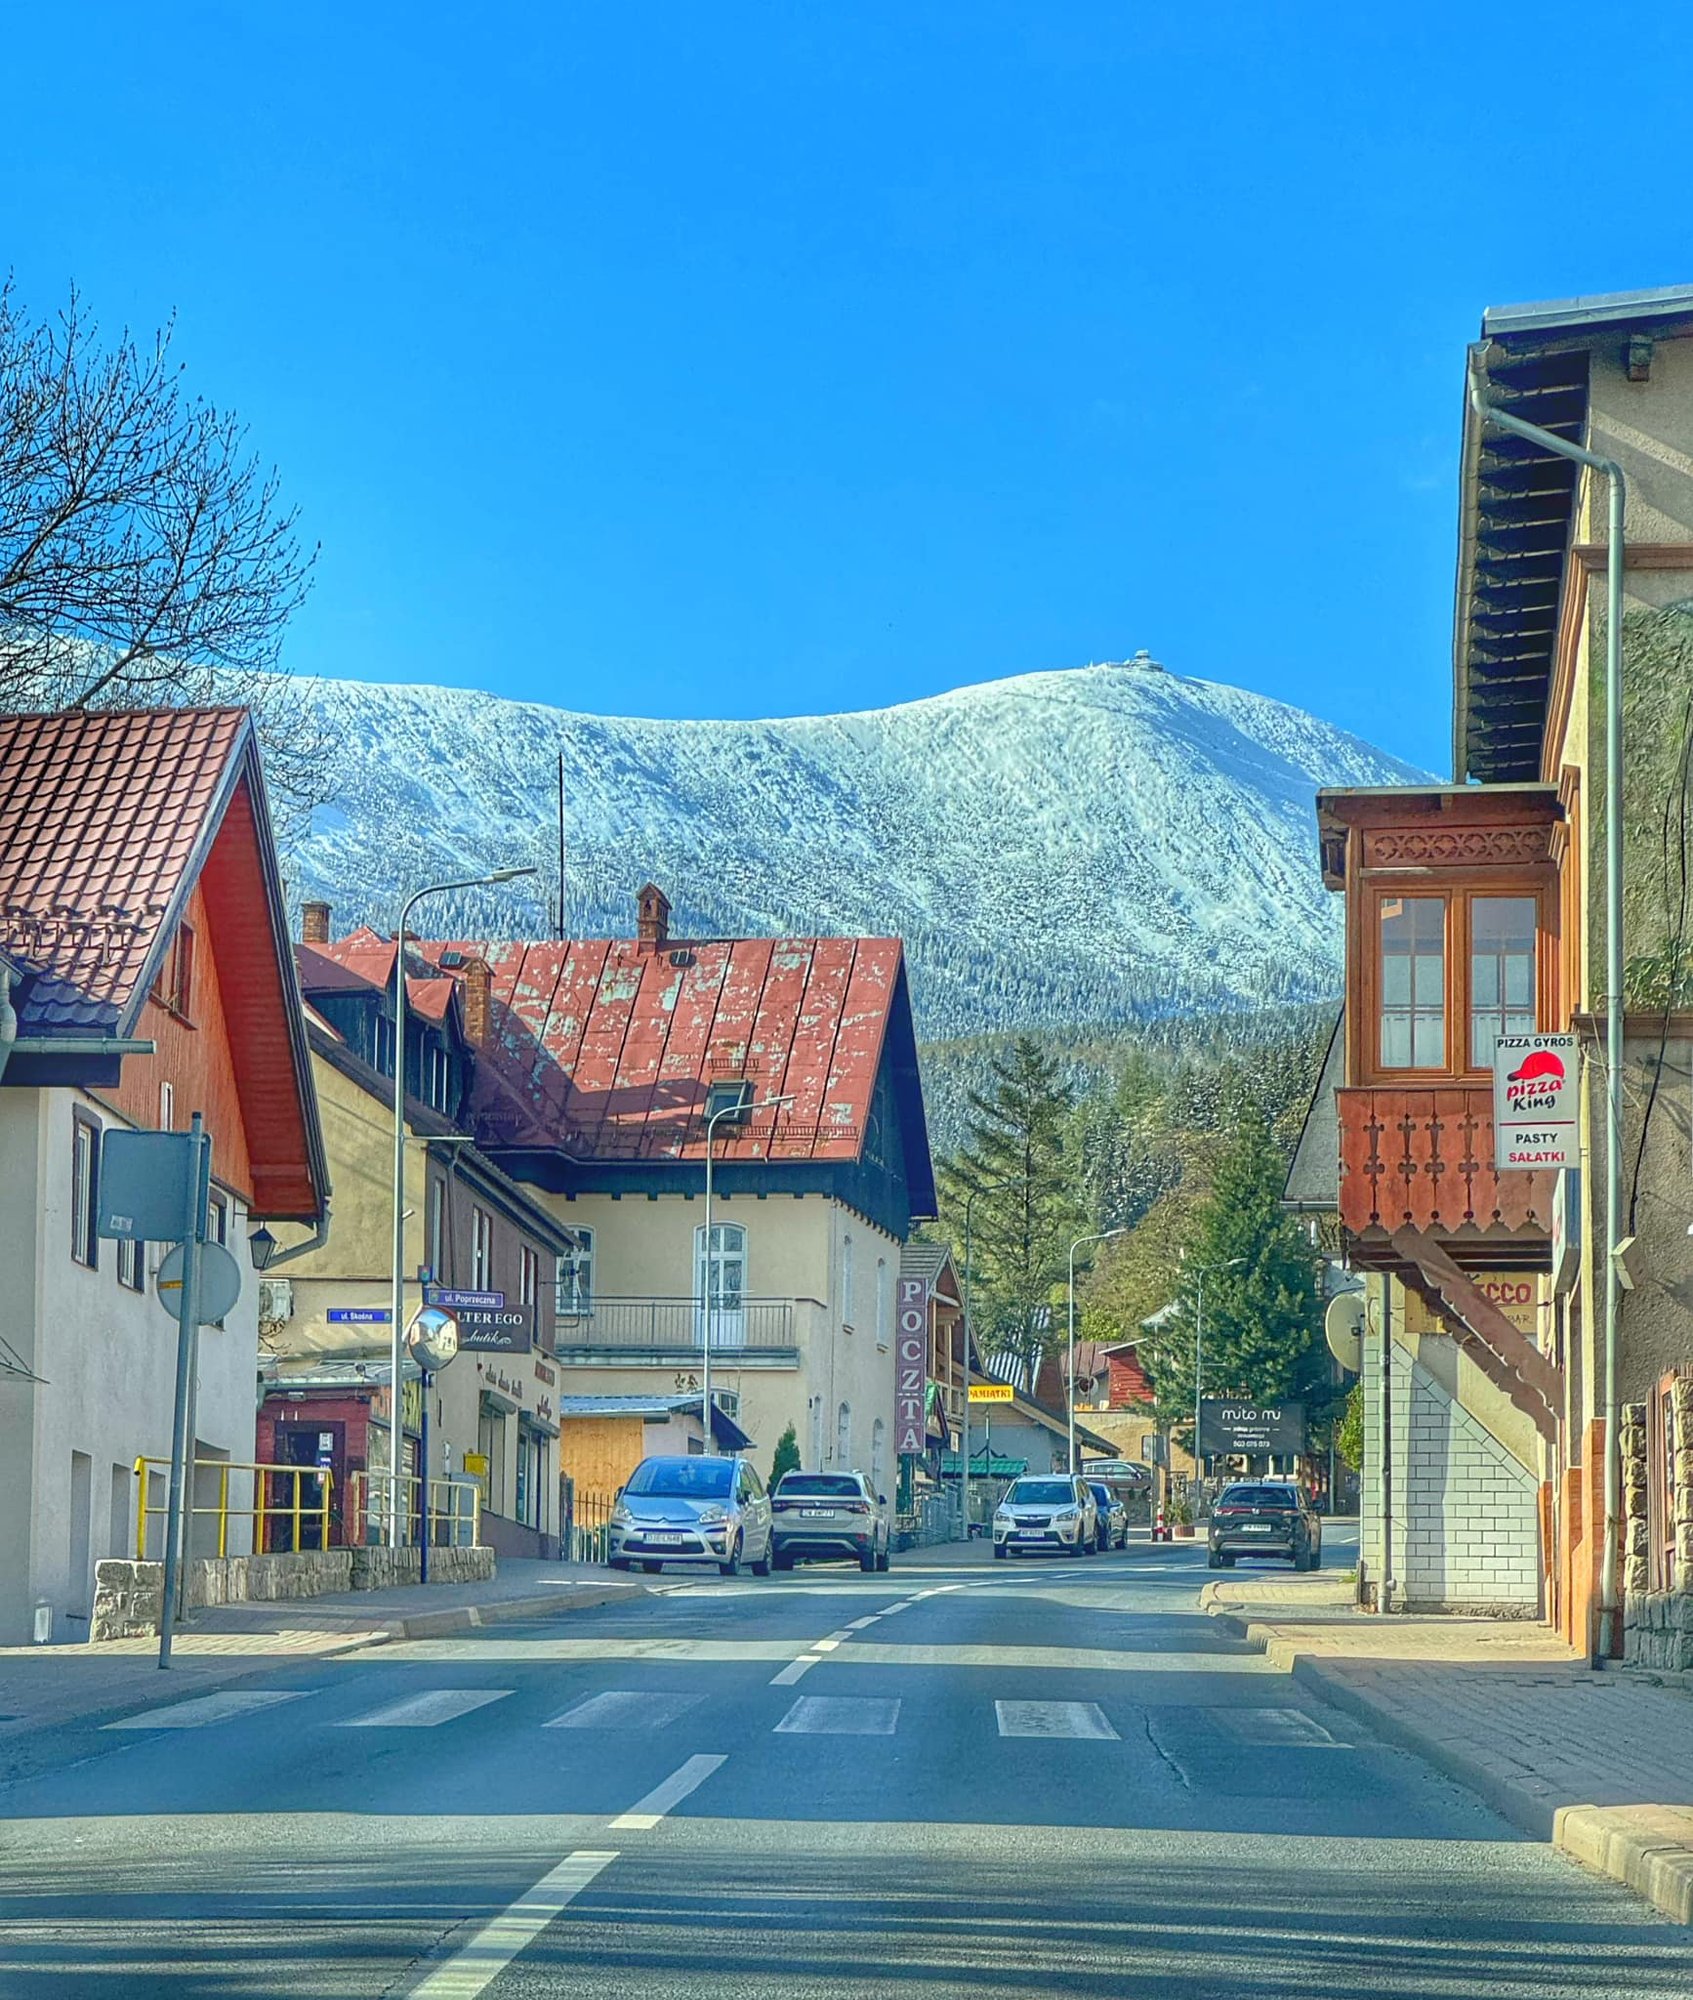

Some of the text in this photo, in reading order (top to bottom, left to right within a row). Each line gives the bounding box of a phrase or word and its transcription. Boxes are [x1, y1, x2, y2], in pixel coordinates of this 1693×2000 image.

[1497, 1037, 1574, 1048] PIZZA GYROS
[1507, 1080, 1563, 1101] pizza
[1513, 1095, 1556, 1112] King
[1515, 1133, 1558, 1144] PASTY
[1509, 1151, 1565, 1163] SAŁATKI
[445, 1294, 496, 1305] ul. Poprzeczna
[340, 1311, 350, 1320] ul.
[457, 1312, 523, 1325] LTER EGO
[468, 1329, 499, 1344] butik
[899, 1281, 922, 1450] POCZTA
